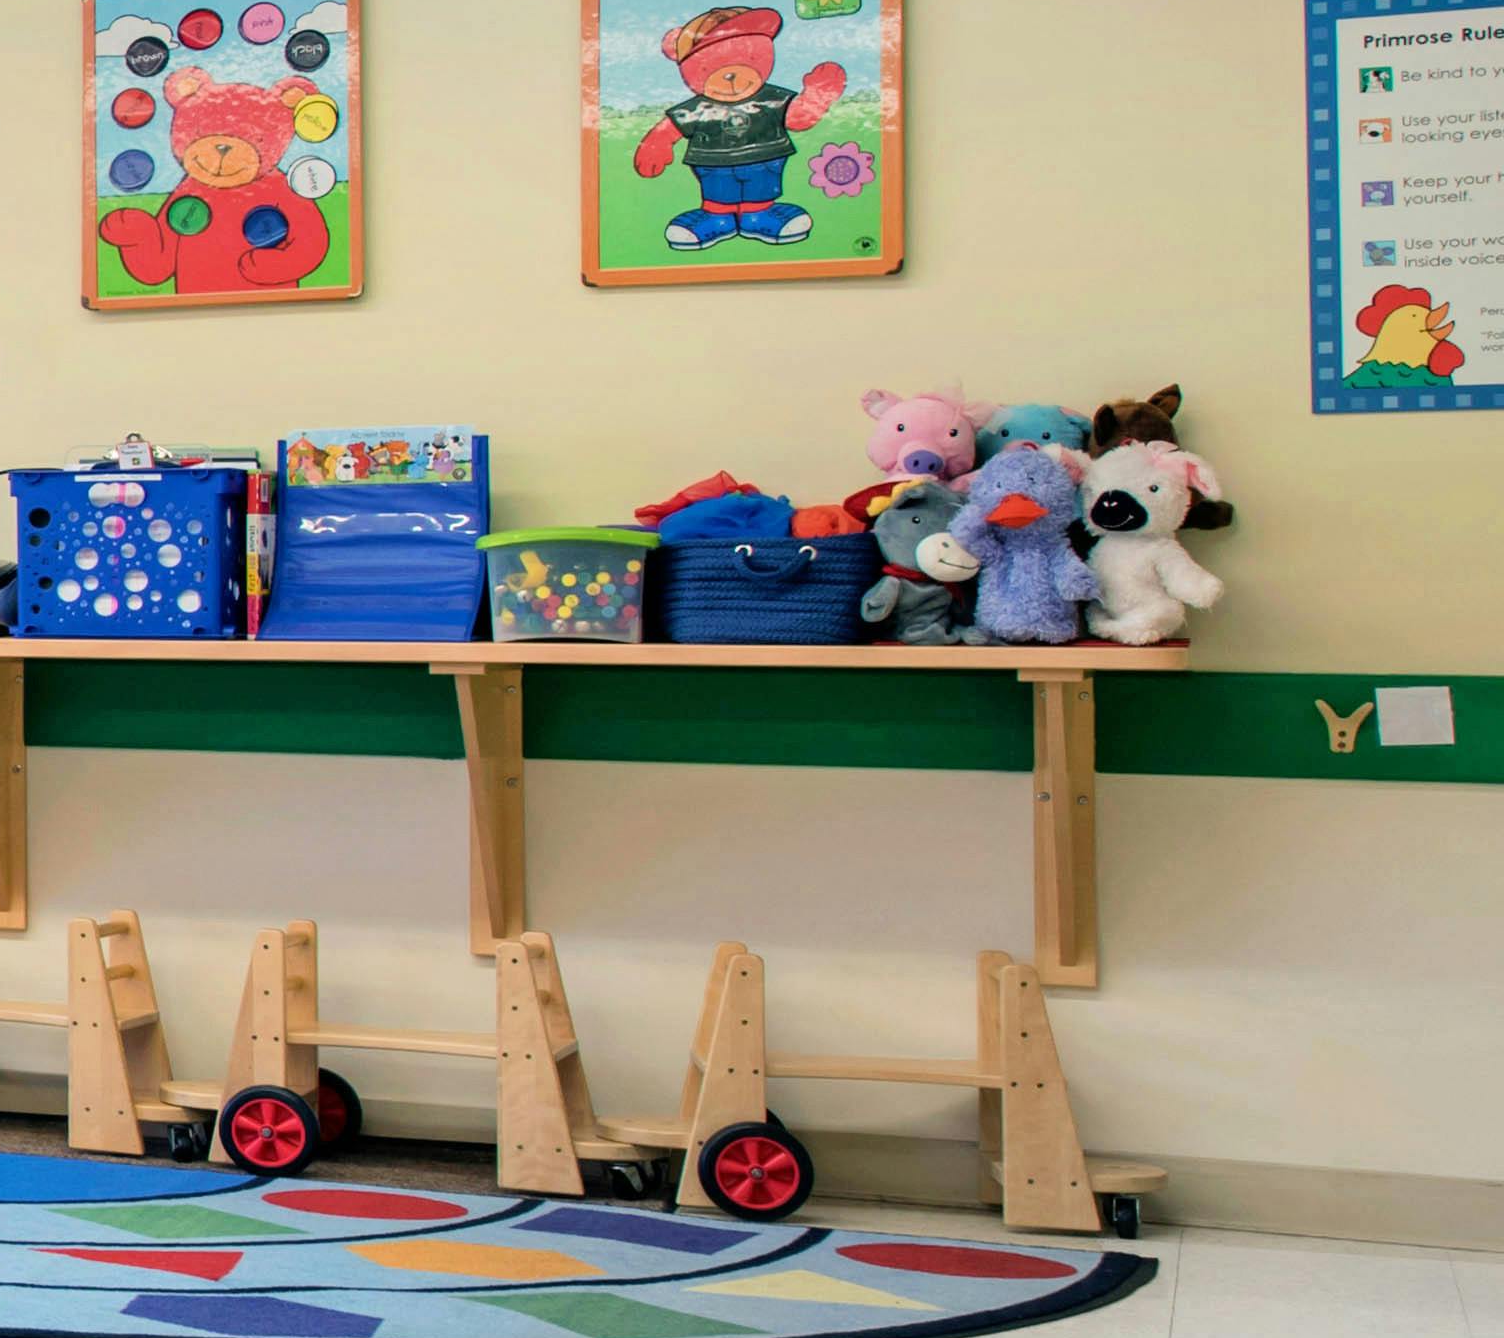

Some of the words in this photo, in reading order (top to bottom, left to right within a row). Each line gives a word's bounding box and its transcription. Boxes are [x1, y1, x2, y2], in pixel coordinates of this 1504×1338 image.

[1363, 31, 1453, 49] Primrose
[1401, 70, 1422, 82] Be
[1427, 66, 1463, 80] kind
[1469, 65, 1487, 78] to
[1402, 114, 1431, 128] Use
[1437, 113, 1475, 127] your
[1401, 128, 1464, 144] looking
[1403, 176, 1448, 192] Keep
[1454, 172, 1492, 188] your
[1403, 190, 1472, 208] yourself.
[1403, 238, 1433, 251] Use
[1439, 236, 1476, 253] your
[1404, 255, 1453, 269] inside
